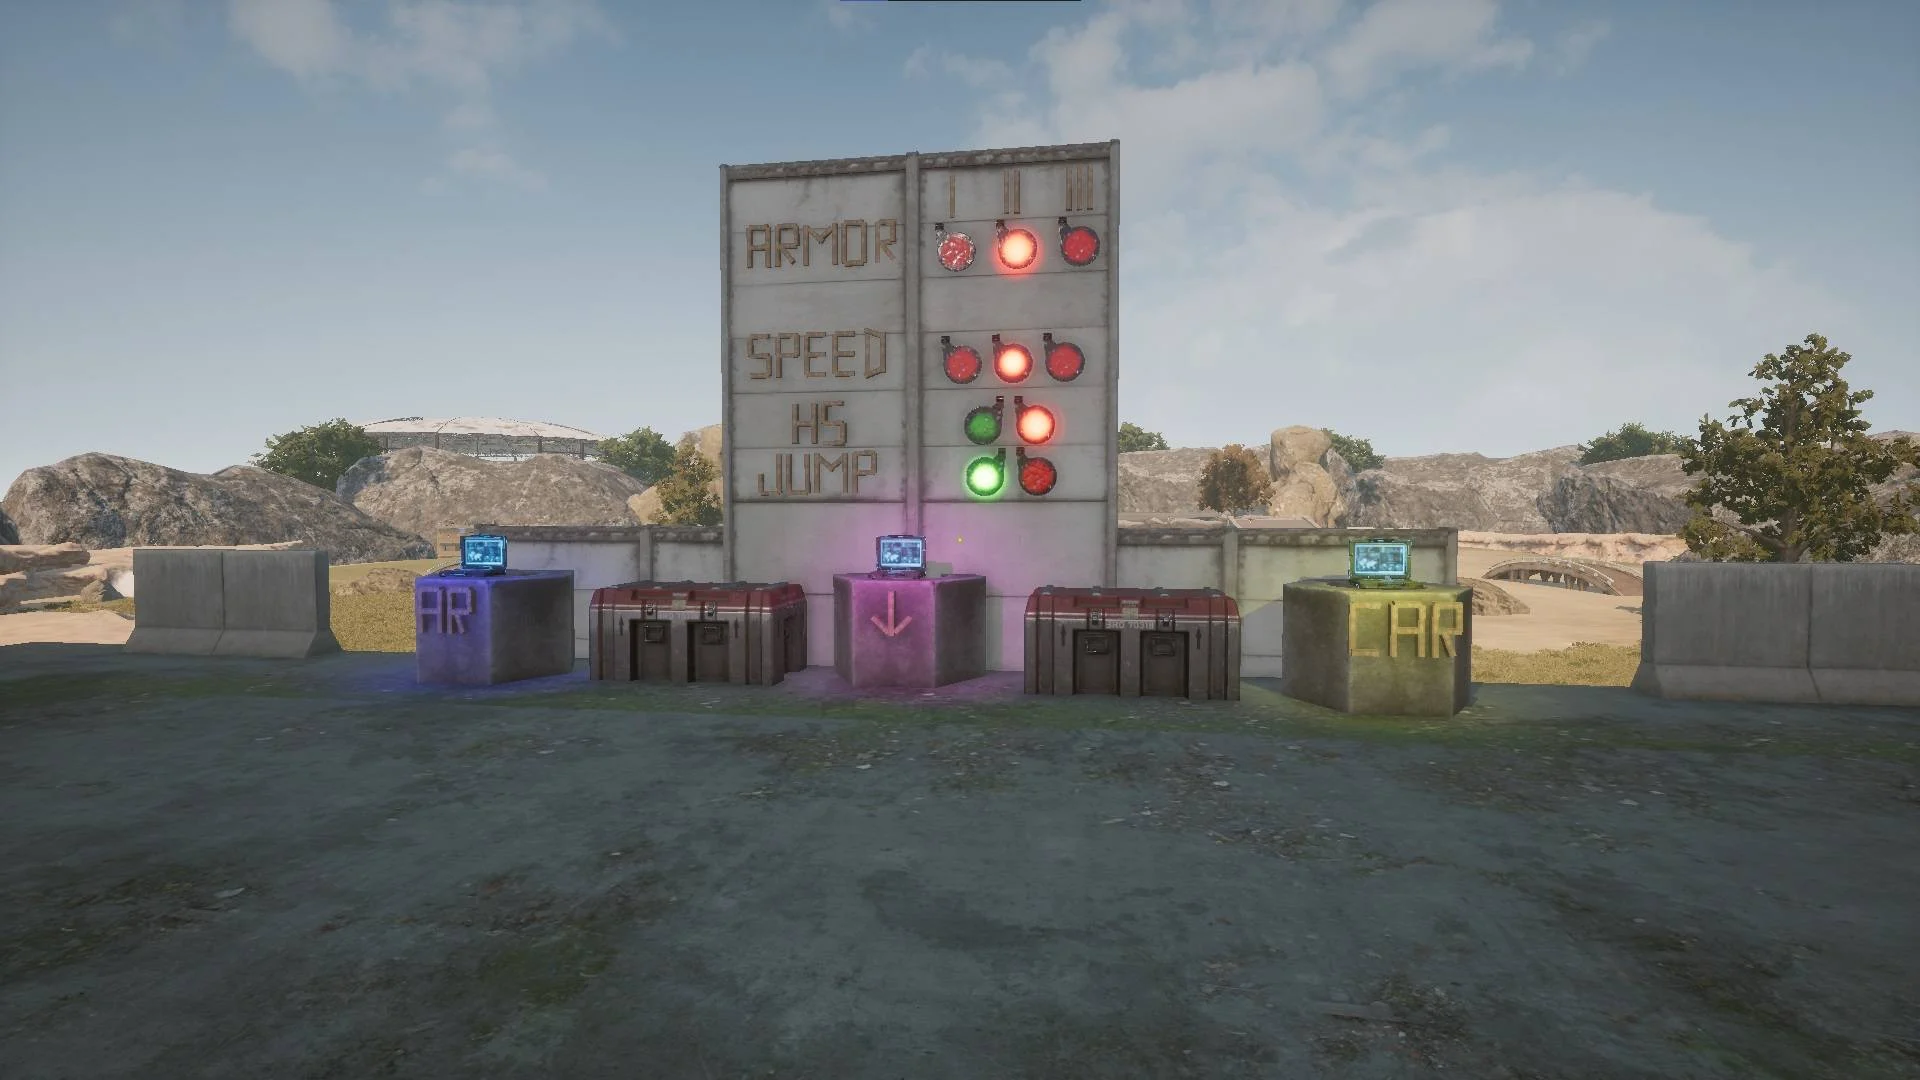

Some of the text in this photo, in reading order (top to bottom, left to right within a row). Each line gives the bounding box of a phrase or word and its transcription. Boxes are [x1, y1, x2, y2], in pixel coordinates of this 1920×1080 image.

[745, 218, 897, 269] ARMOR
[746, 327, 887, 380] SPEED
[791, 400, 848, 447] HS
[757, 449, 878, 498] JUMP
[416, 586, 473, 634] AR
[1349, 600, 1464, 659] CAR
